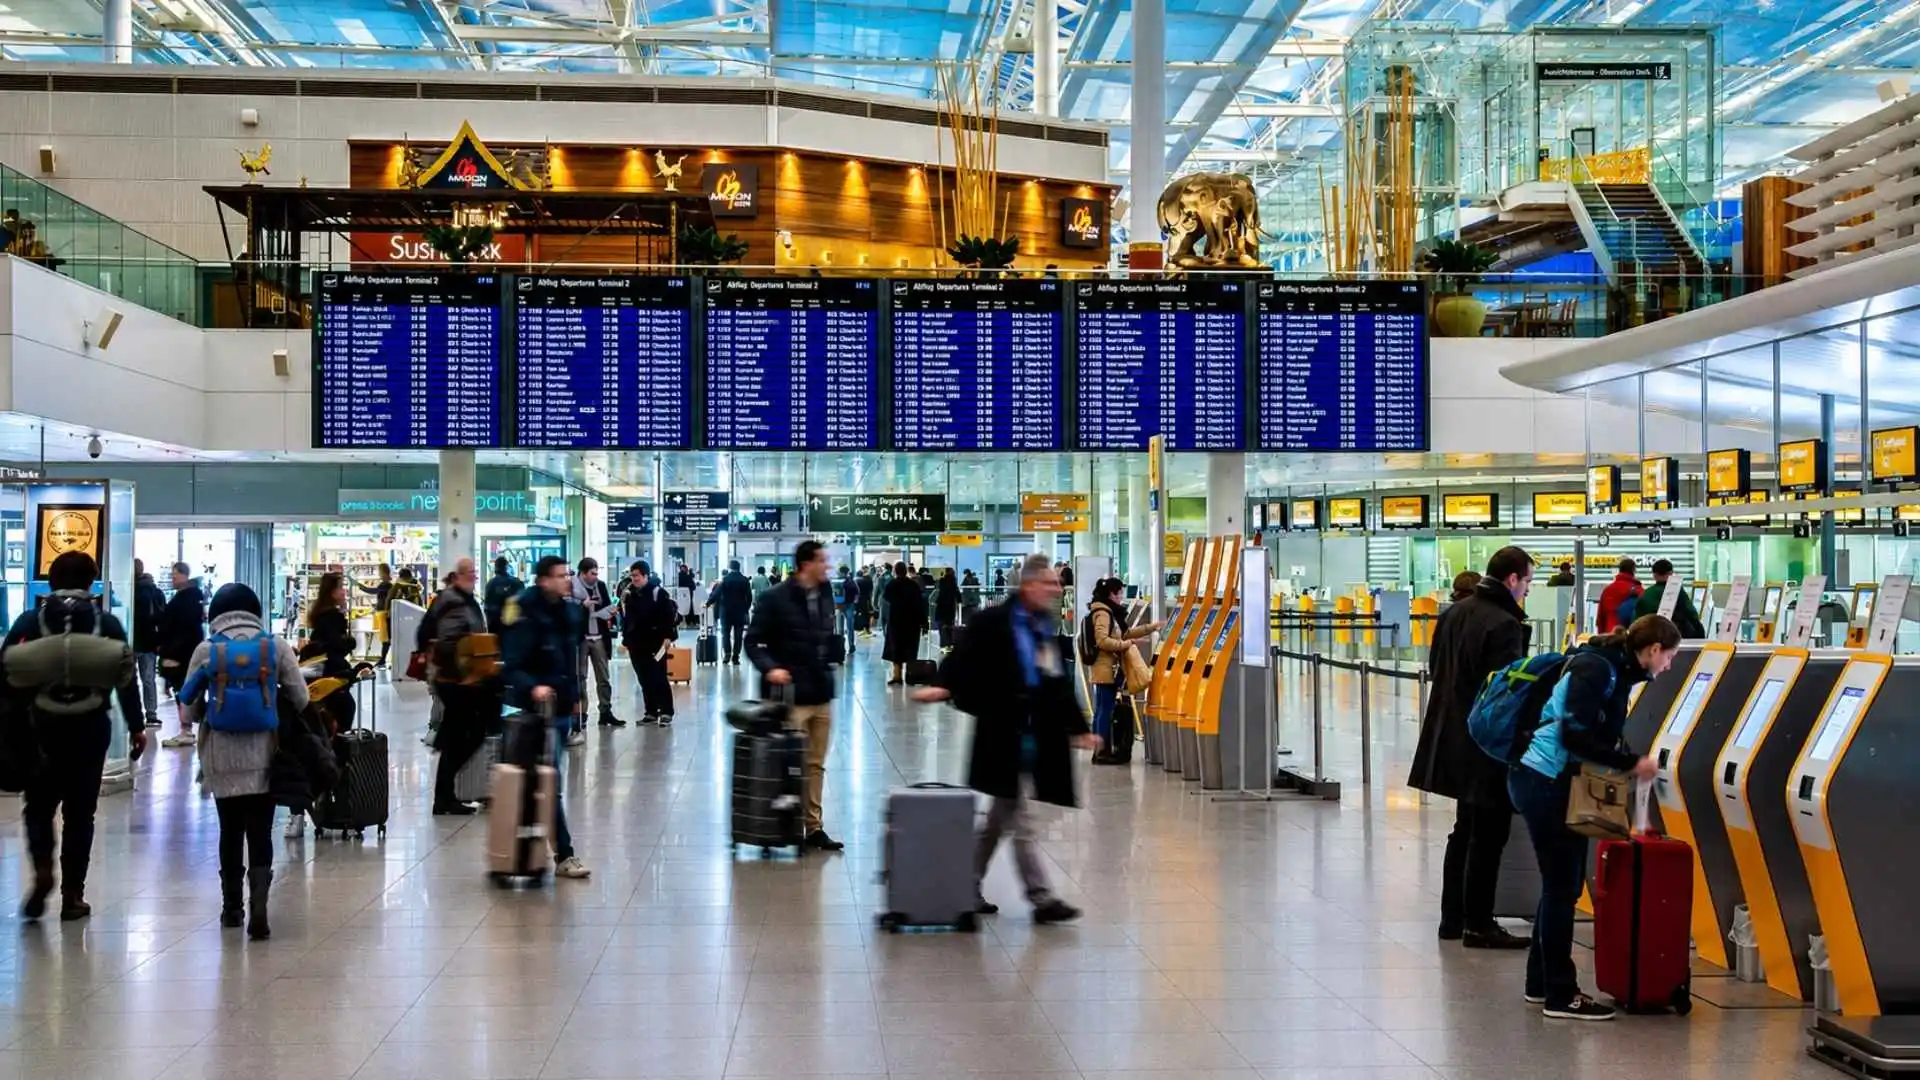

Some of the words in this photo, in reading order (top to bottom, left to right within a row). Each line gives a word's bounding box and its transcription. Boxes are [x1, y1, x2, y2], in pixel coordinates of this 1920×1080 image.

[368, 276, 402, 285] Departures
[434, 277, 439, 285] 2
[561, 279, 595, 288] Departures
[598, 279, 623, 287] Terminal
[750, 281, 784, 290] Departures
[937, 283, 969, 292] Departures
[998, 283, 1004, 291] 2
[1120, 284, 1152, 293] Departures
[1301, 285, 1333, 294] Departures
[854, 497, 878, 506] Abflug
[879, 497, 918, 506] Departures
[854, 508, 877, 516] Gates
